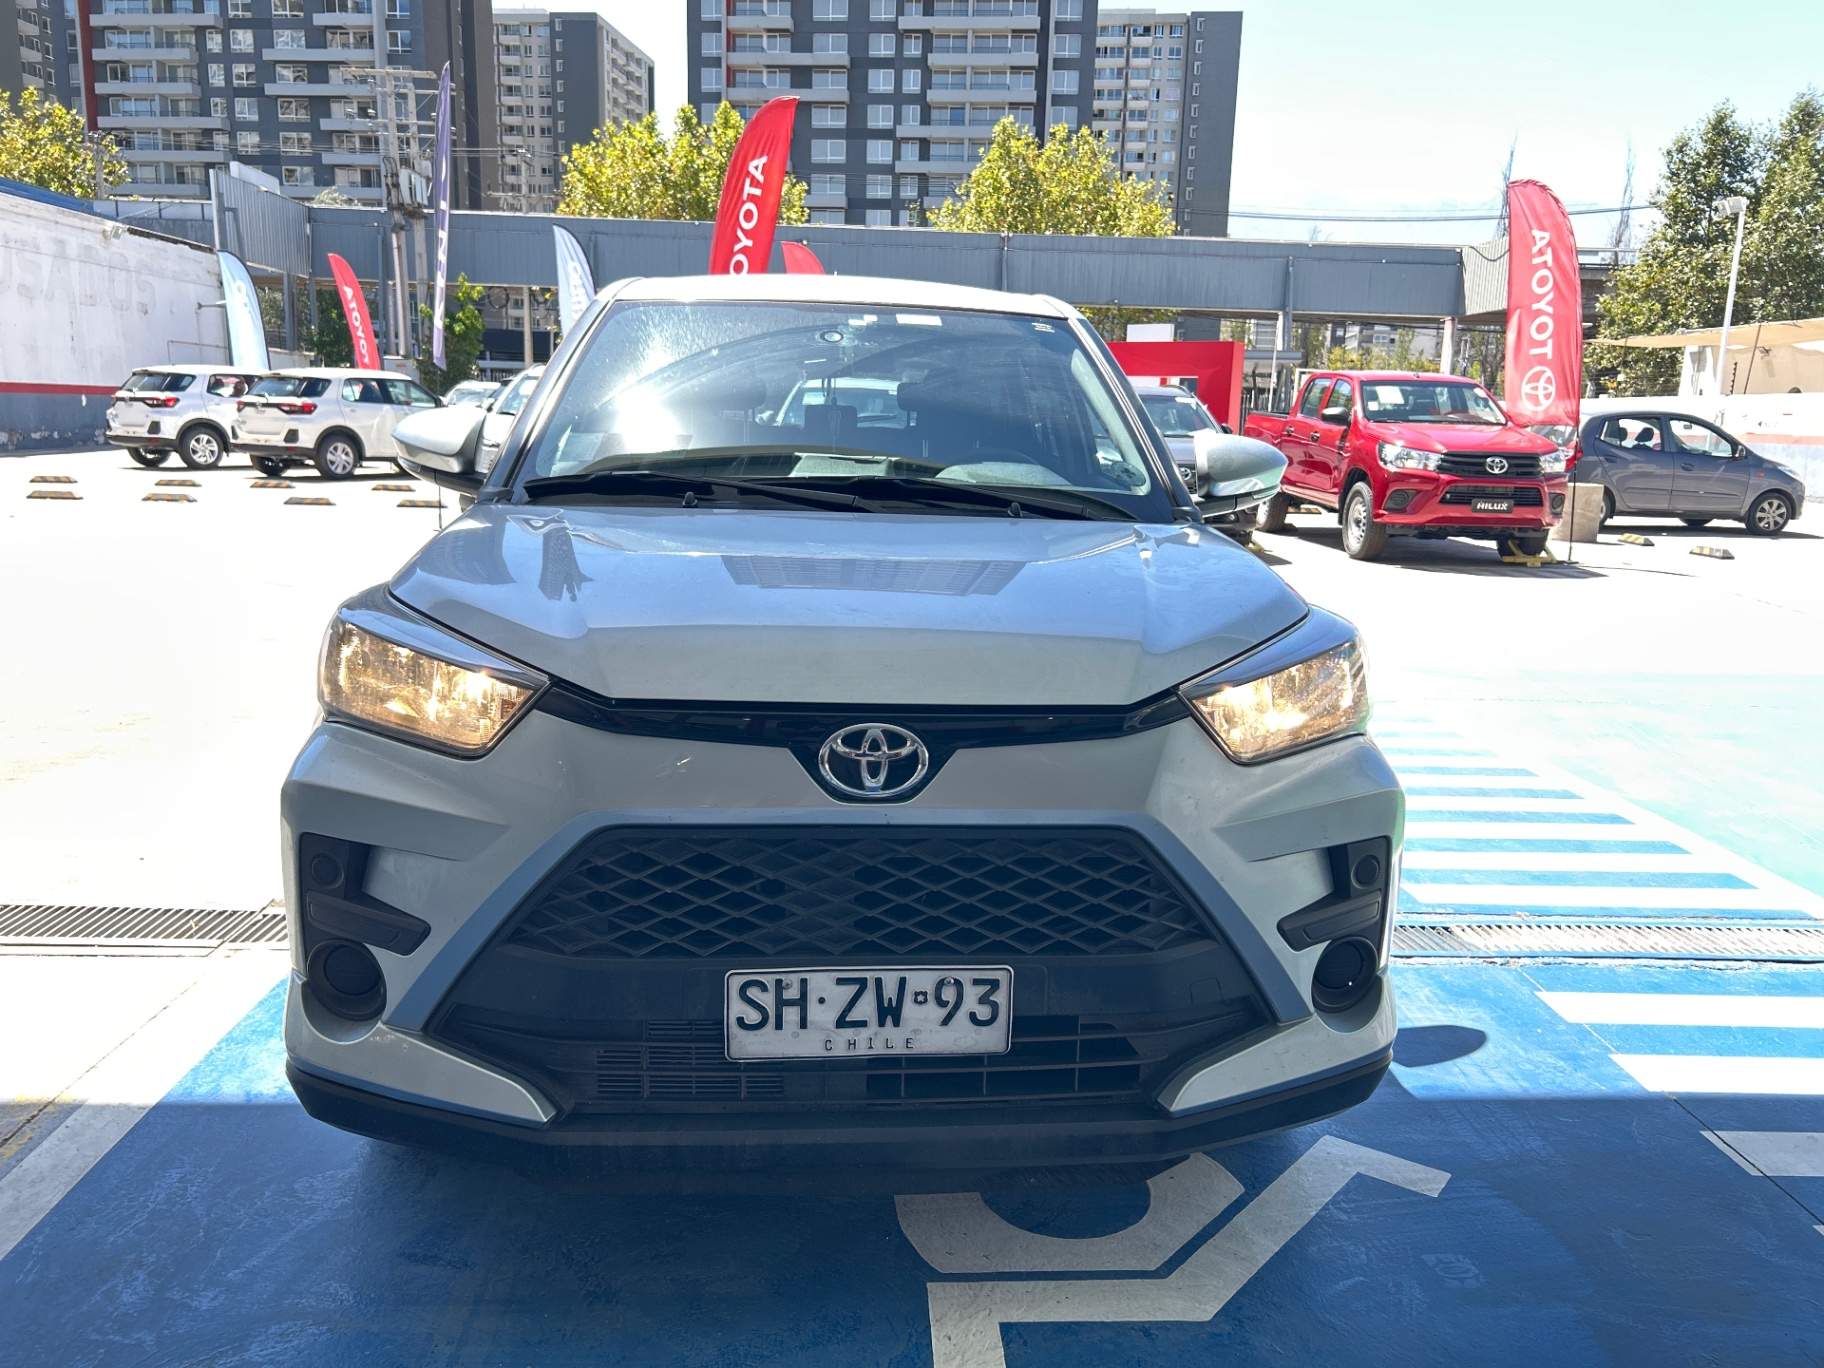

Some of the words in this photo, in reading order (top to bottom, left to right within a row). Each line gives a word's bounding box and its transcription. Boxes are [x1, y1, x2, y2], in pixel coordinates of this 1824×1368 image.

[730, 155, 768, 275] OYOTA
[1476, 502, 1508, 511] HILUX
[824, 1037, 914, 1051] CHILE
